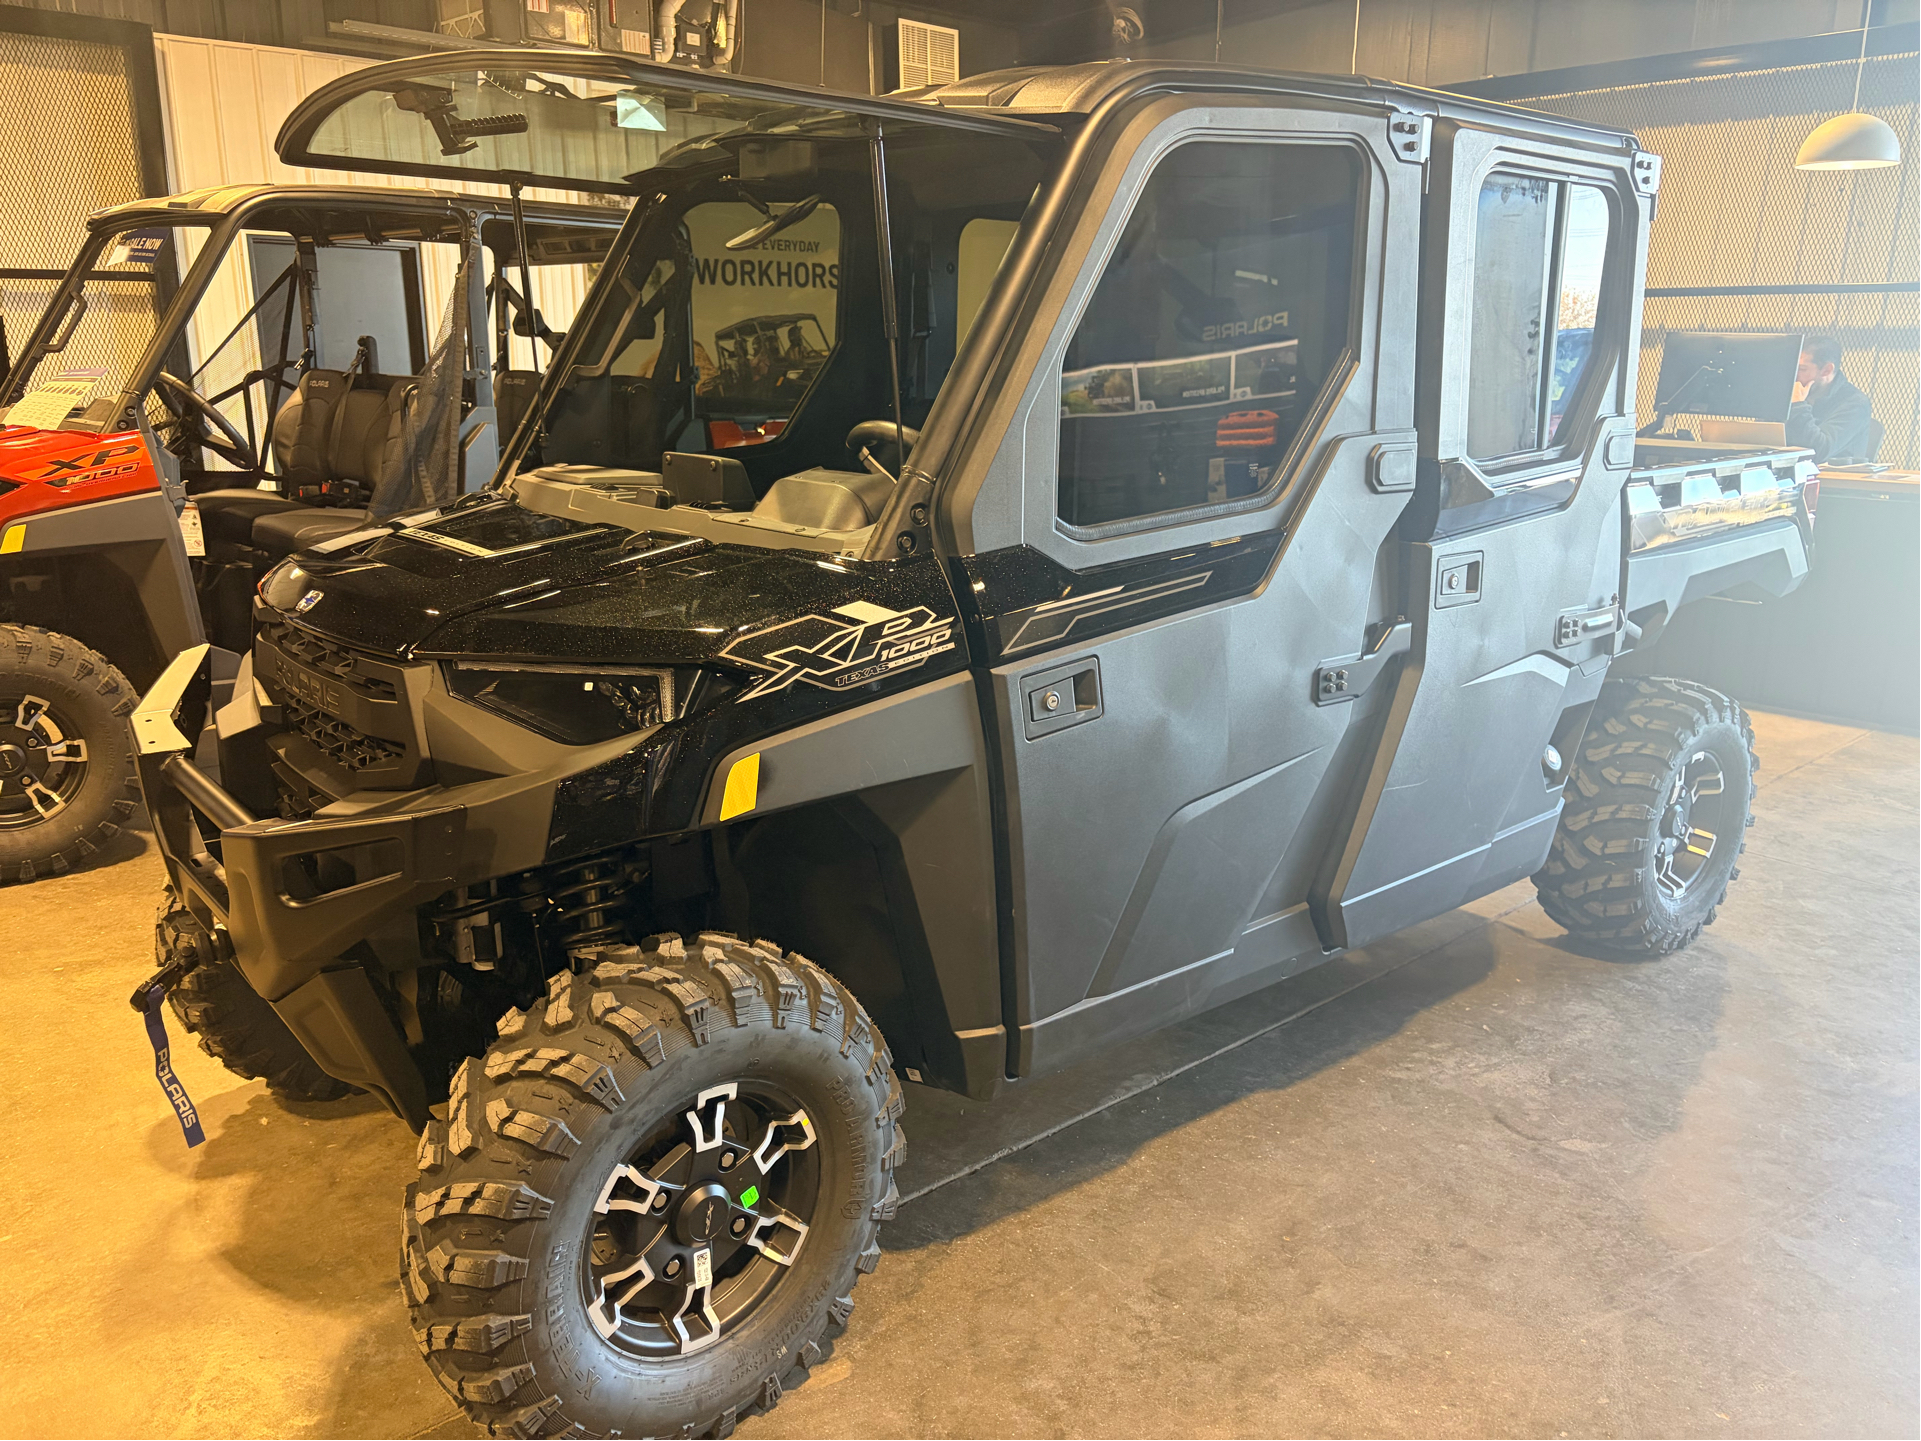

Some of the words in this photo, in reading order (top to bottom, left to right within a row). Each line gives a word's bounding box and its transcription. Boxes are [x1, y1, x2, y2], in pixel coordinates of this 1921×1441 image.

[143, 238, 164, 250] NOW
[762, 239, 820, 253] EVERYDAY
[309, 380, 330, 388] POLARIS
[37, 444, 140, 479] XP
[66, 463, 140, 485] 1000
[735, 605, 955, 704] XP
[879, 629, 952, 661] 1000
[835, 662, 891, 687] TEXAS
[894, 644, 950, 665] EDITION
[157, 1047, 197, 1129] POLARIS
[826, 1075, 857, 1116] PRO
[846, 1116, 867, 1198] ARMOR
[546, 1239, 602, 1402] X-TERRAIN
[776, 1345, 789, 1359] WS
